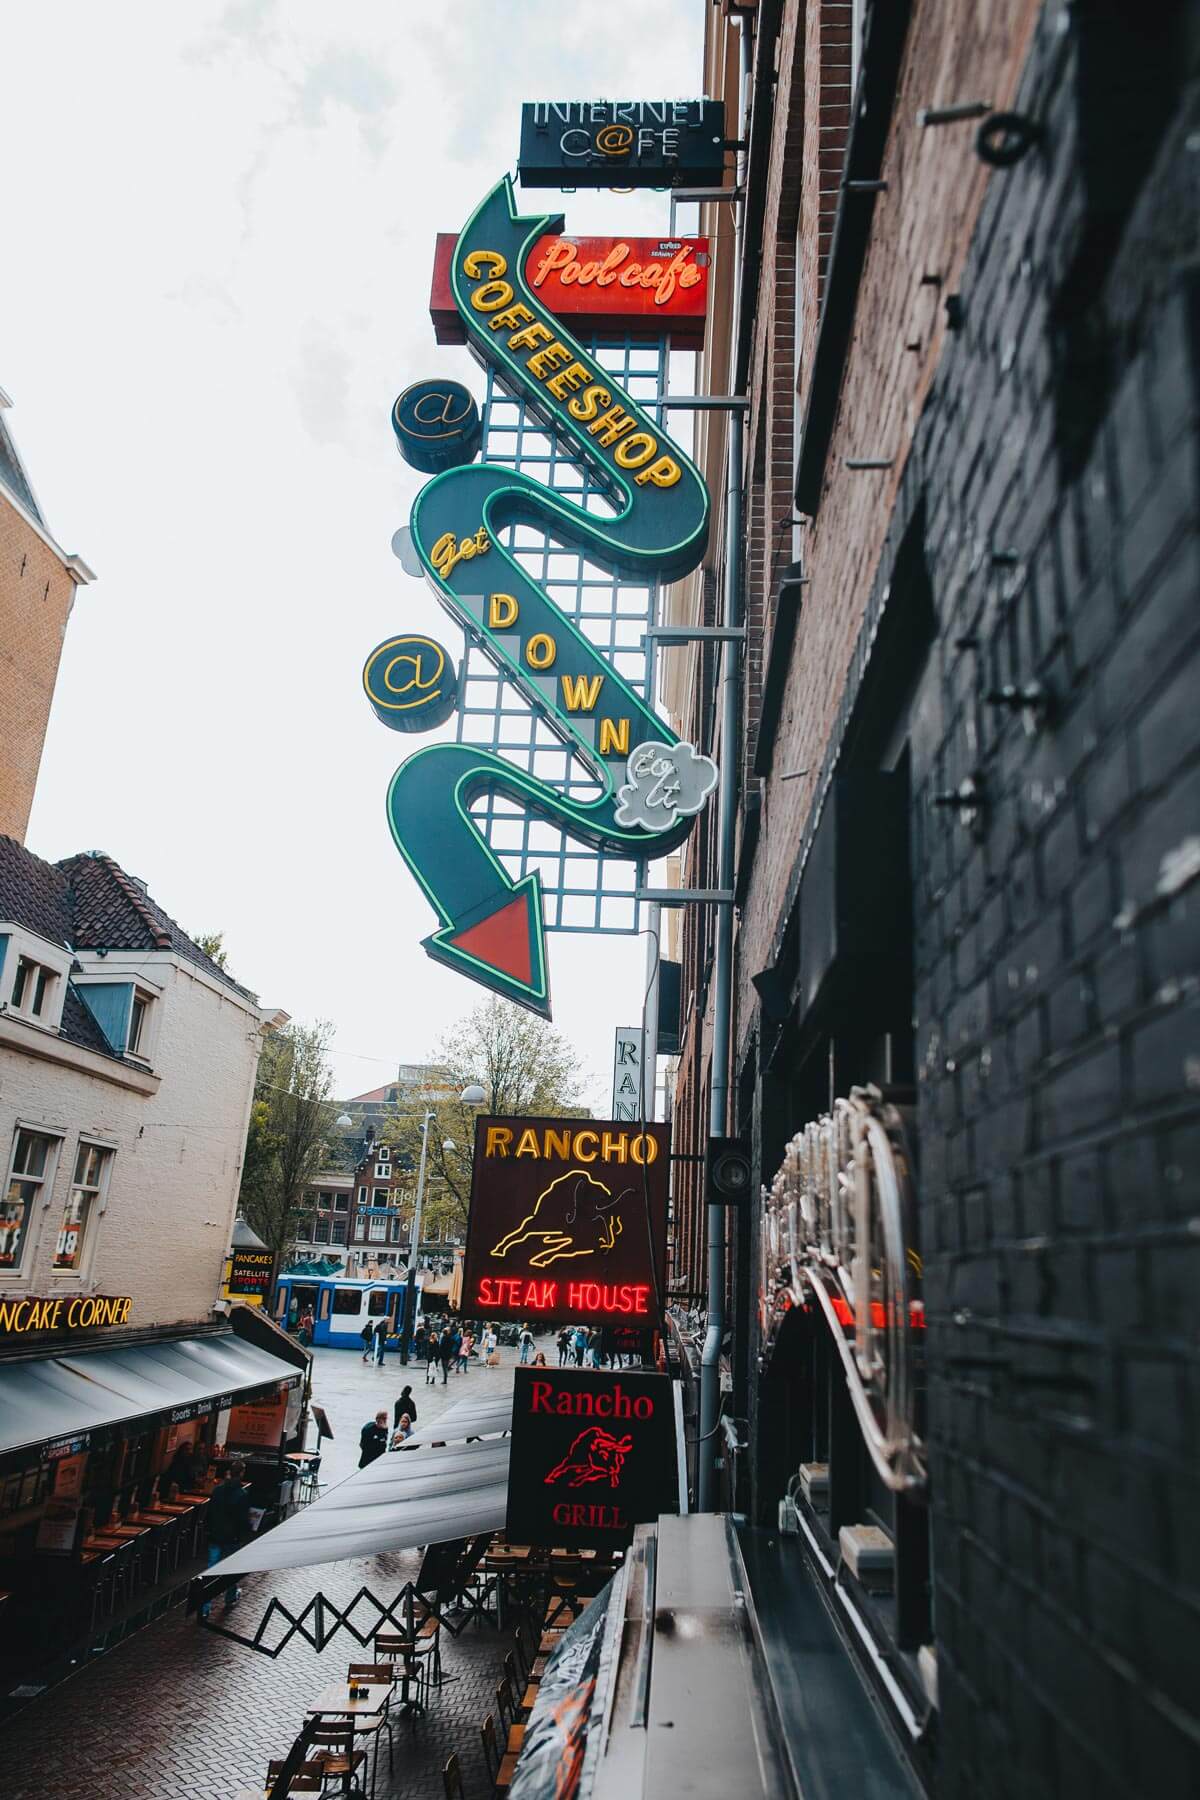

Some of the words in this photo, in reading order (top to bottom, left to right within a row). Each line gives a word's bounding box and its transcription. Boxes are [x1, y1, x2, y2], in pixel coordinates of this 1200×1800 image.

[533, 98, 706, 124] INTERNET
[560, 125, 680, 157] C@FE
[533, 242, 630, 288] Pool
[621, 245, 702, 305] cafe
[463, 250, 682, 489] COFFEESHOP
[489, 593, 632, 756] DOWN
[485, 1126, 659, 1166] RANCHO
[233, 1269, 271, 1278] SATELLITE
[236, 1254, 273, 1265] PANCAKES
[67, 1298, 132, 1328] CORNER
[477, 1278, 557, 1310] STEAK
[569, 1282, 650, 1314] HOUSE
[528, 1381, 655, 1419] Rancho
[552, 1503, 629, 1529] GRILL
